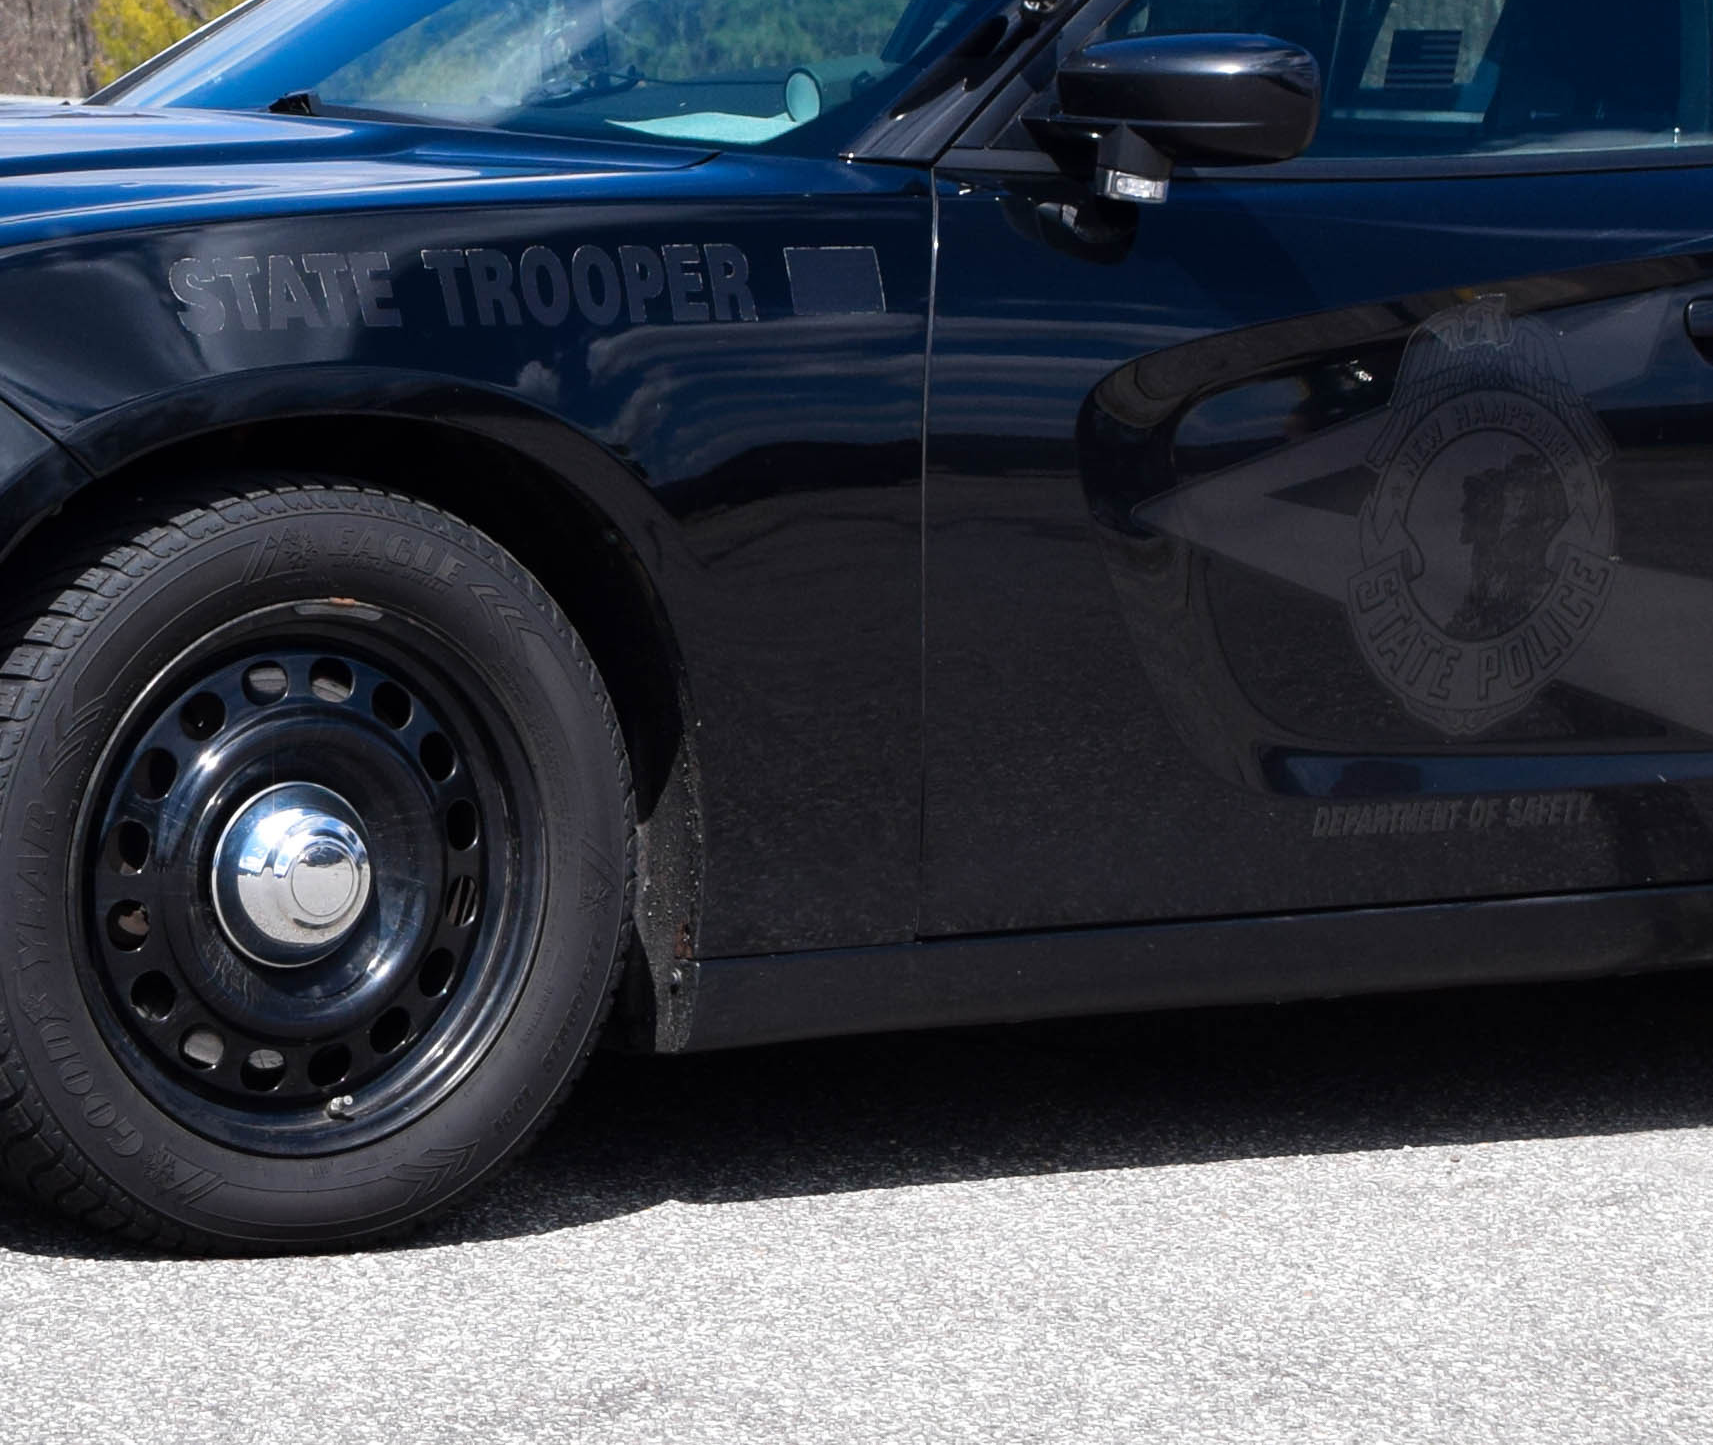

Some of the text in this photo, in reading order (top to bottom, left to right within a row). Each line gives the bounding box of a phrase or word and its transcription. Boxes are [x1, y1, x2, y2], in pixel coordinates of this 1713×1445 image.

[169, 243, 759, 336] STATE TROOPER
[1405, 401, 1584, 476] NEW HAMPSHIRE
[328, 525, 467, 587] EAGLE
[1355, 556, 1611, 700] STATE POLICE
[1312, 792, 1594, 838] DEPARTMENT OF SAFETY
[15, 802, 144, 1158] GOODYEAR
